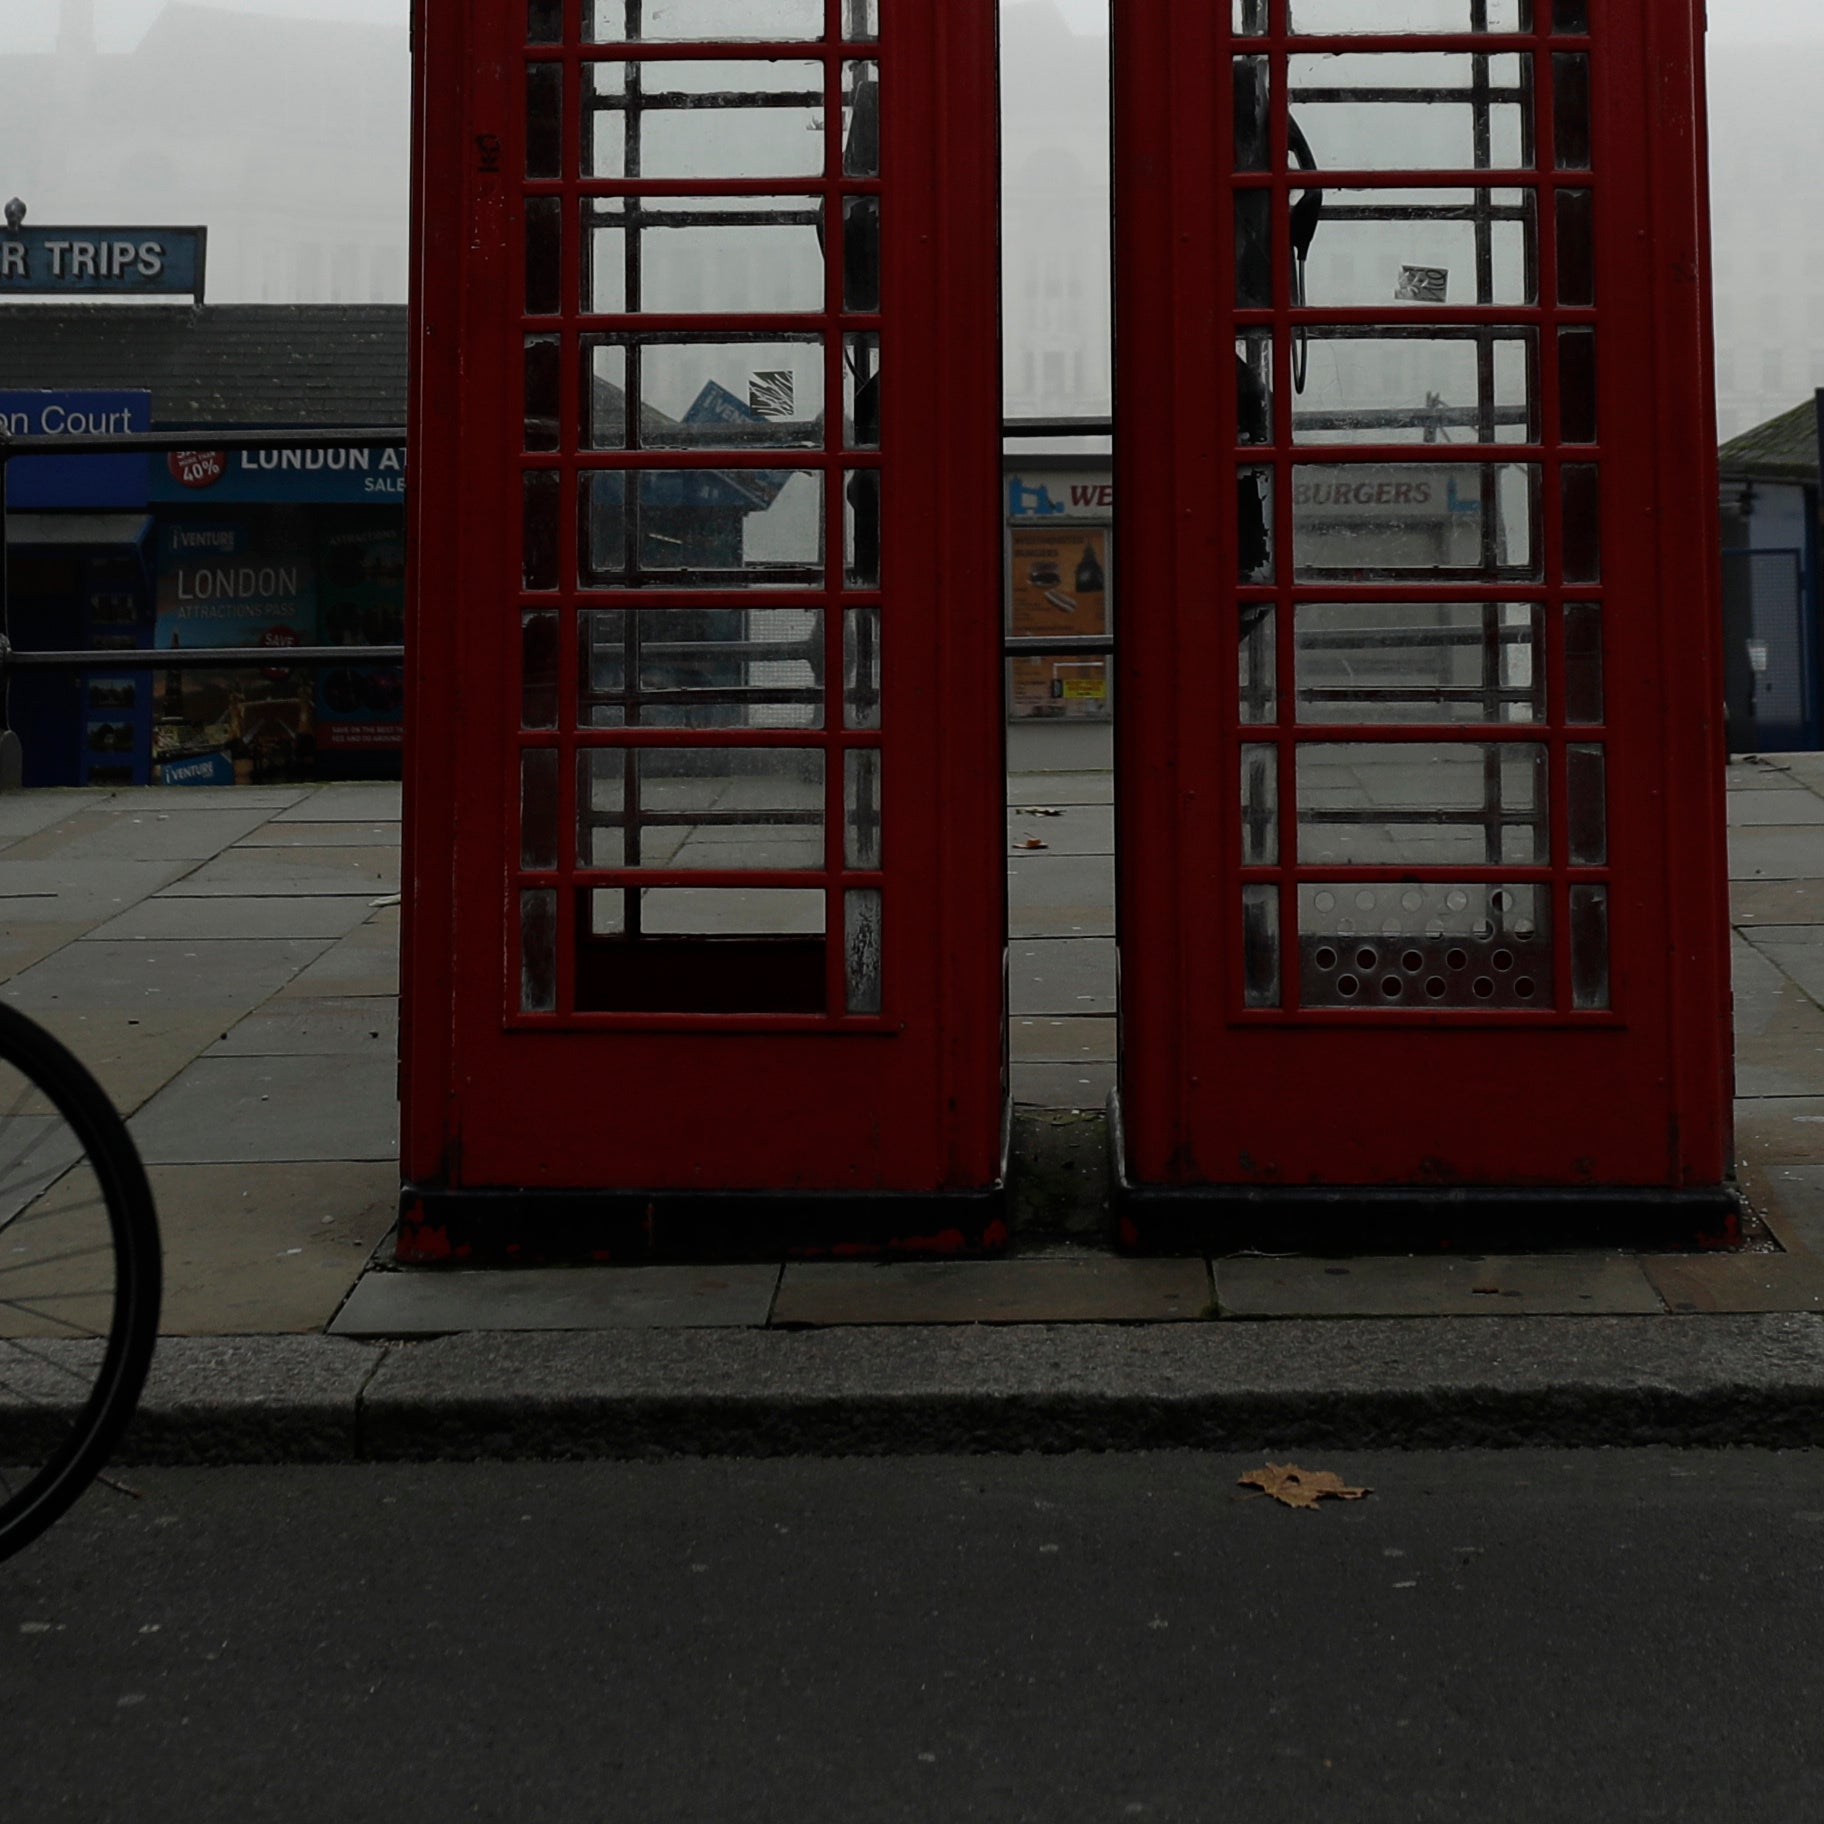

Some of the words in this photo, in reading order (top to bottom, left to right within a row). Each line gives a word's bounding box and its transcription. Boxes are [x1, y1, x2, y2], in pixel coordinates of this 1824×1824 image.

[44, 240, 166, 277] TRIPS
[40, 405, 133, 435] Court
[182, 458, 222, 482] 40%
[240, 447, 371, 471] LONDON
[1070, 484, 1113, 507] WE
[1292, 482, 1434, 506] BURGERS
[177, 567, 298, 601] LONDON
[178, 604, 264, 620] ATTRACTIONS
[264, 602, 297, 617] PASS
[264, 632, 295, 648] SAVE
